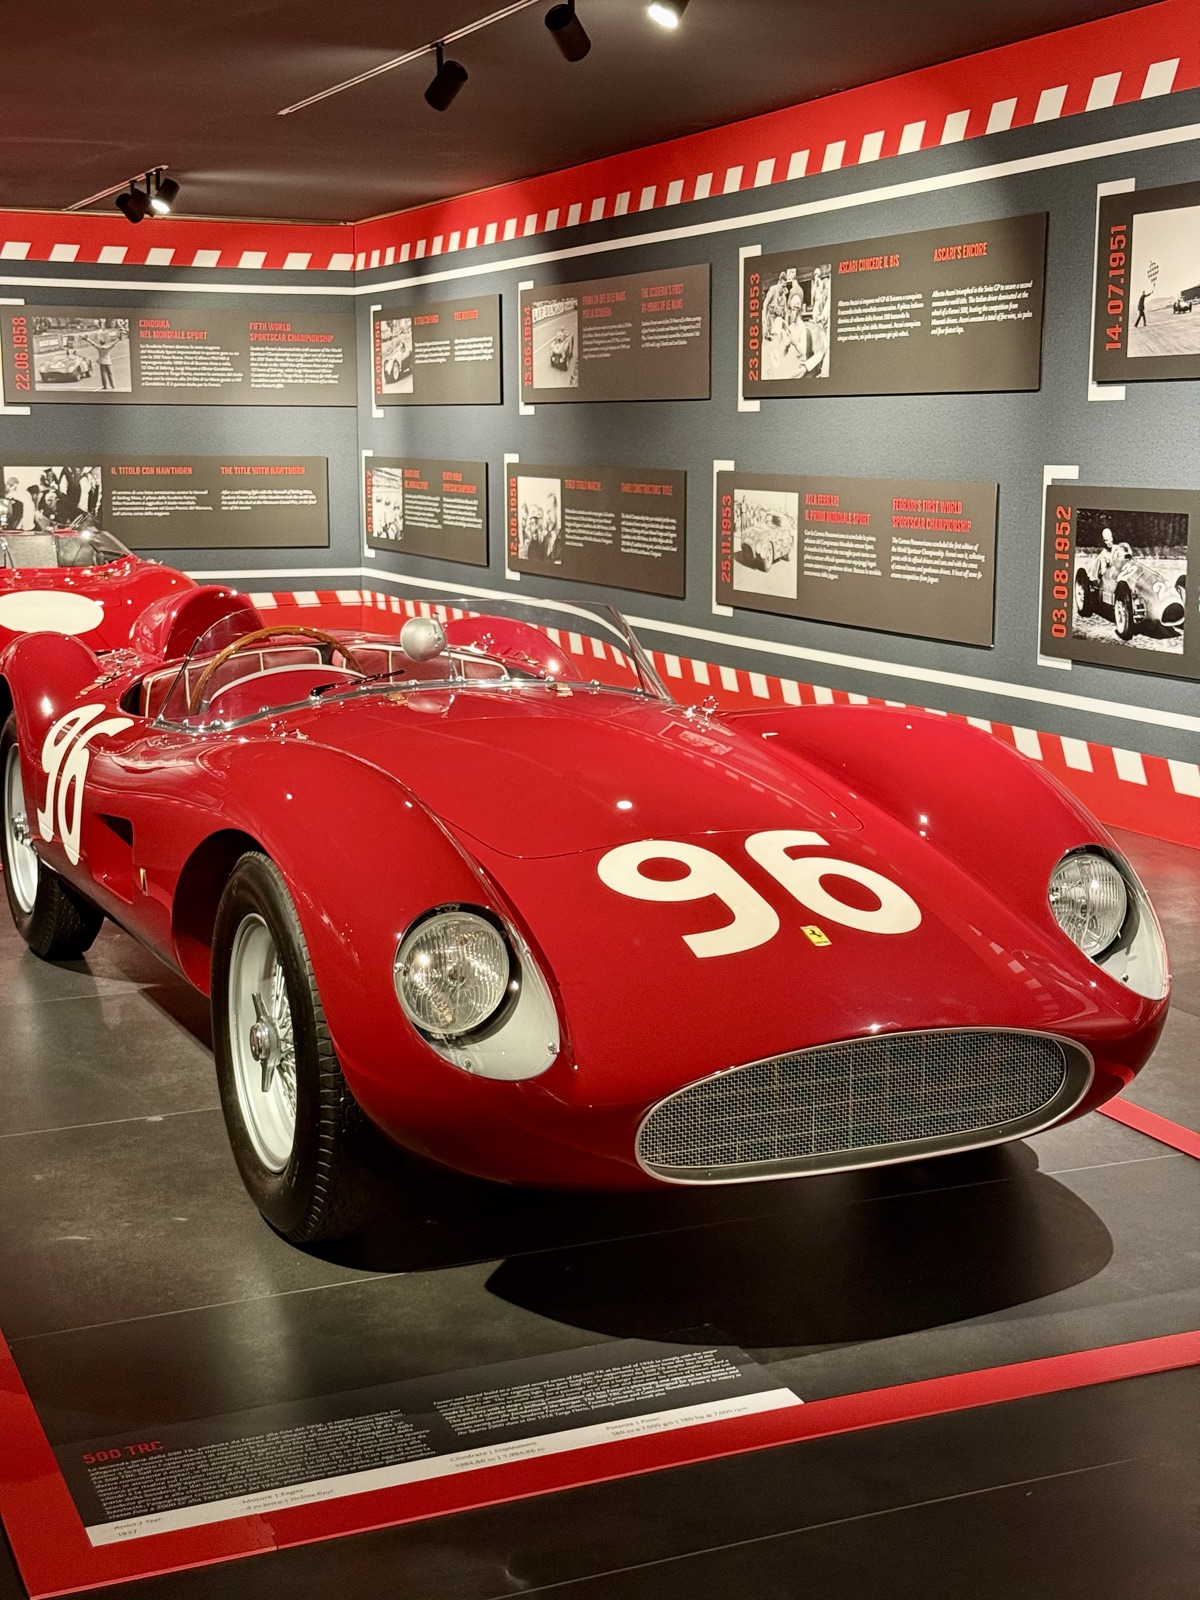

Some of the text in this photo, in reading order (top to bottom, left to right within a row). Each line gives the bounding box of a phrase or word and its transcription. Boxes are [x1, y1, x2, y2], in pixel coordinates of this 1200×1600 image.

[934, 242, 988, 262] ASCARI'S ENCORE
[838, 260, 858, 274] ASCARI
[884, 256, 890, 269] IL
[890, 254, 900, 268] BIS
[1106, 224, 1126, 350] 14.07.1951
[186, 332, 208, 340] SPORT
[268, 323, 291, 332] WORLD
[749, 272, 760, 380] 23.08.1953
[250, 333, 286, 342] SPORTSCAR
[524, 305, 532, 386] 13.06.1954
[12, 316, 30, 390] 22.06.1958
[111, 466, 193, 475] IL TITOLO CON HAWTHORN
[220, 466, 234, 475] THE
[234, 466, 252, 475] TITLE
[922, 500, 940, 512] FIRST
[940, 502, 962, 514] WORLD
[853, 513, 870, 526] SPORT
[892, 516, 972, 532] SPORTSCAR CHAMPIONSHIP
[722, 495, 732, 582] 25.11.1953
[1052, 505, 1072, 638] 03.08.1952
[37, 704, 134, 866] 96
[597, 830, 922, 958] 96
[82, 1441, 164, 1464] 500 TRC
